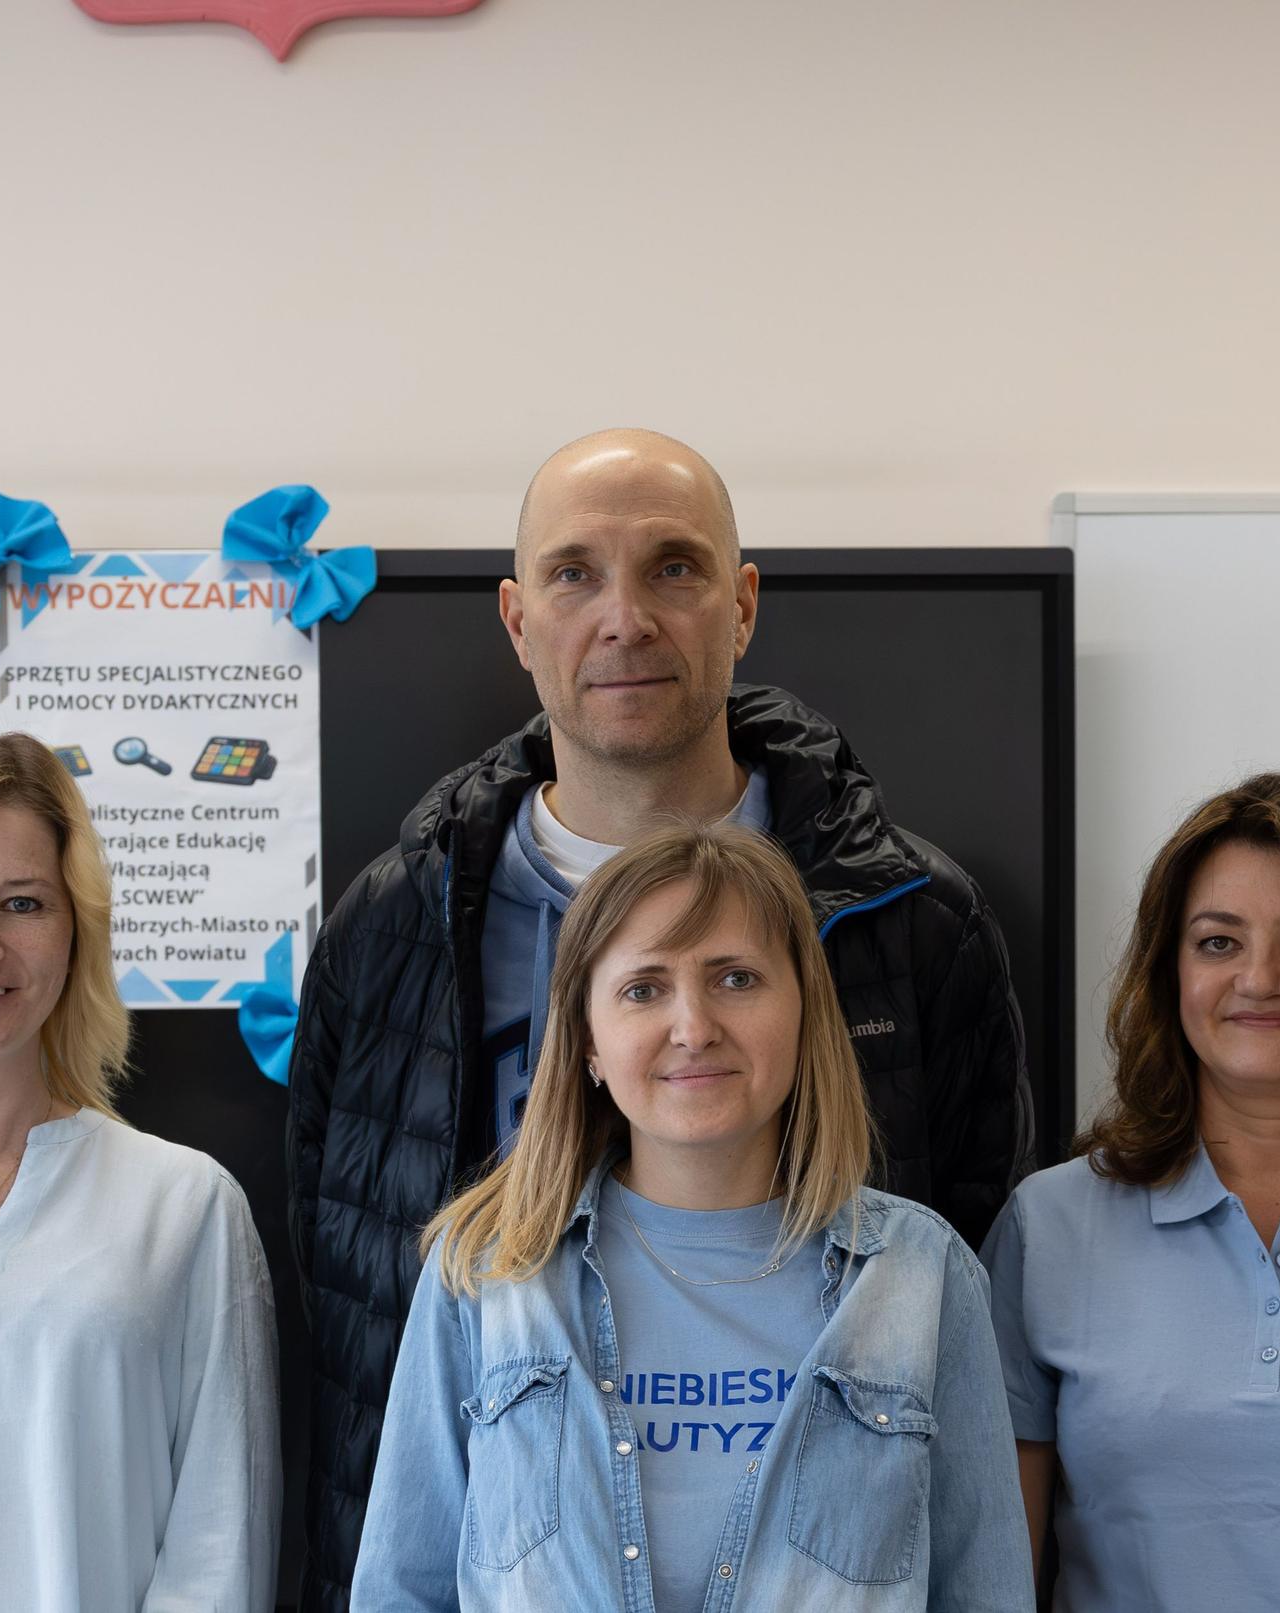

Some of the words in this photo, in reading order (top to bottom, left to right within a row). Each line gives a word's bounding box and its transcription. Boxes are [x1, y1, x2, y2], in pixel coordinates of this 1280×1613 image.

[5, 666, 90, 686] SPRZĘTU
[98, 665, 302, 685] SPECJALISTYCZNEGO
[16, 695, 21, 710] I
[28, 694, 115, 710] POMOCY
[123, 693, 298, 710] DYDAKTYCZNYCH
[191, 804, 280, 821] Centrum
[176, 831, 267, 854] Edukację
[111, 916, 269, 938] ałbrzych-Miasto
[276, 919, 300, 932] na
[164, 945, 246, 961] Powiatu
[848, 1018, 895, 1039] umbia
[637, 1421, 777, 1453] UTYZ
